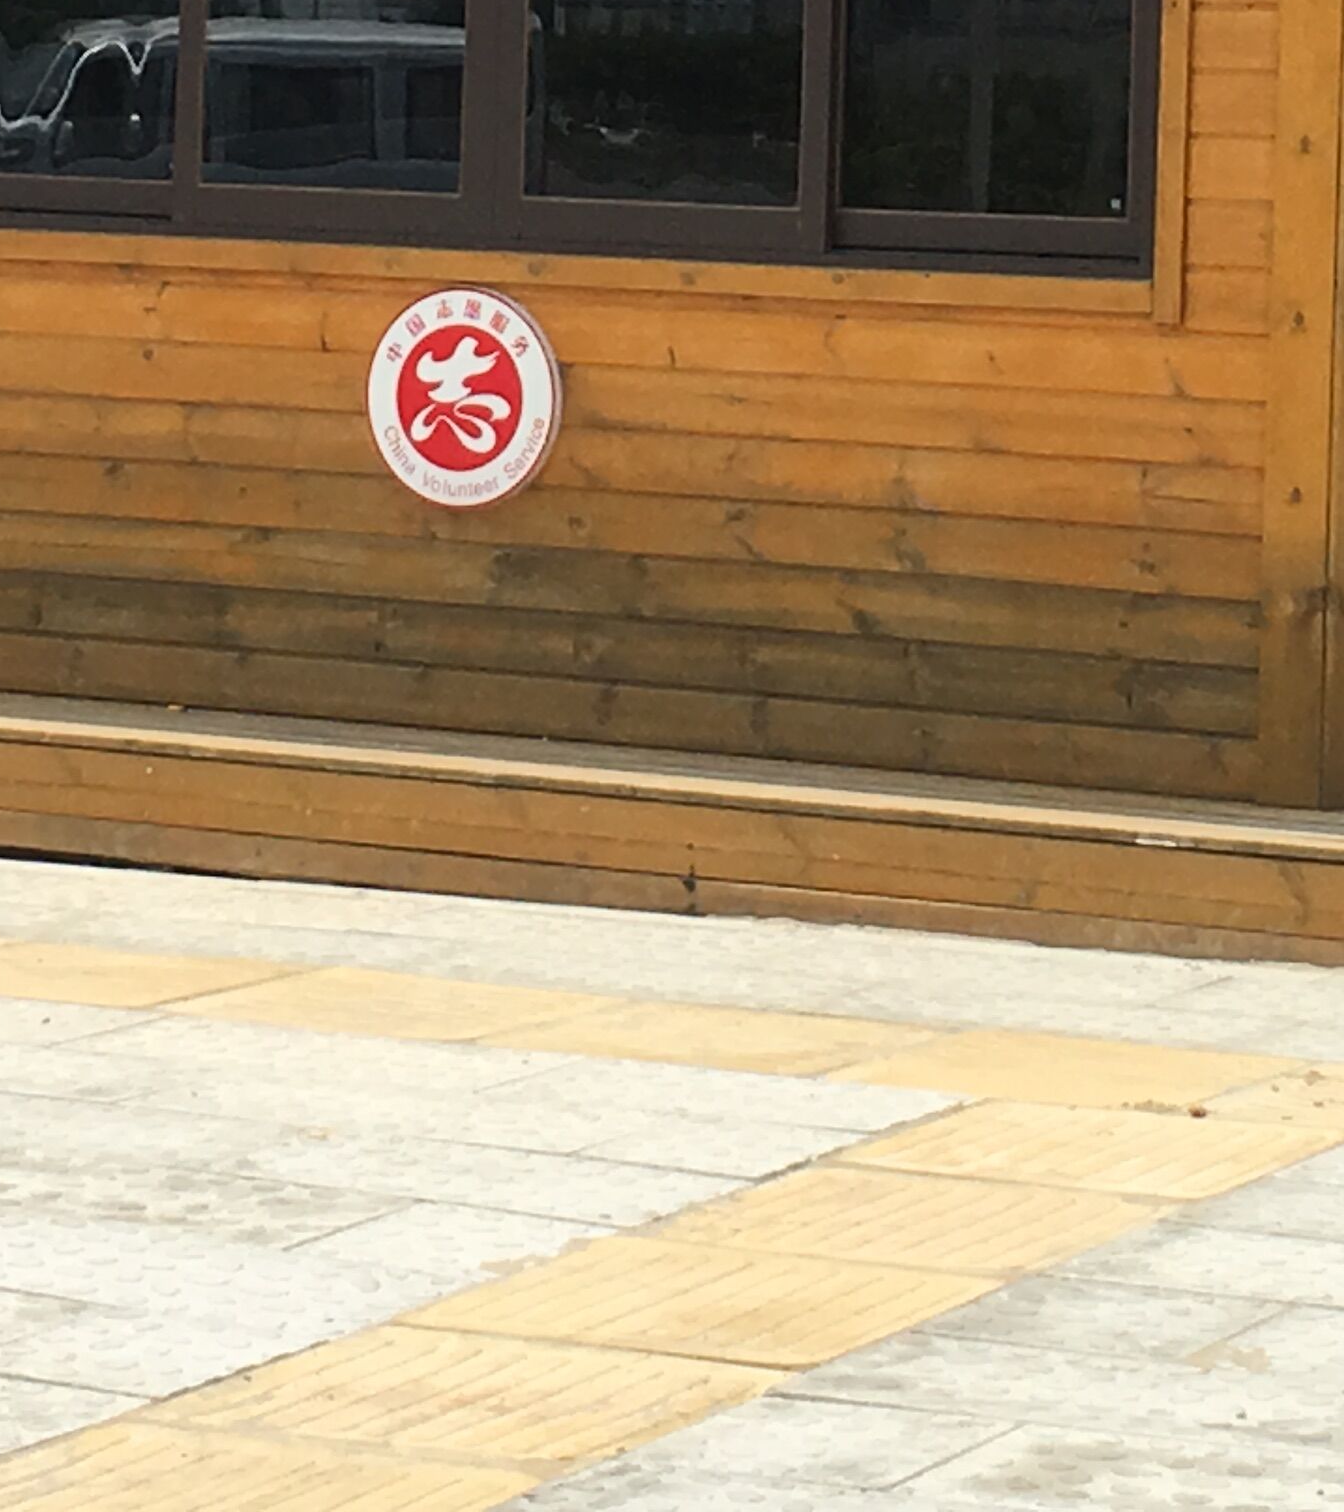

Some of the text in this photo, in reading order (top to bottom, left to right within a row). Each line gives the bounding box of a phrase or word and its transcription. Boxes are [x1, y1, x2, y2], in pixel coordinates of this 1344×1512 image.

[384, 416, 546, 498] China Volunteer Service
